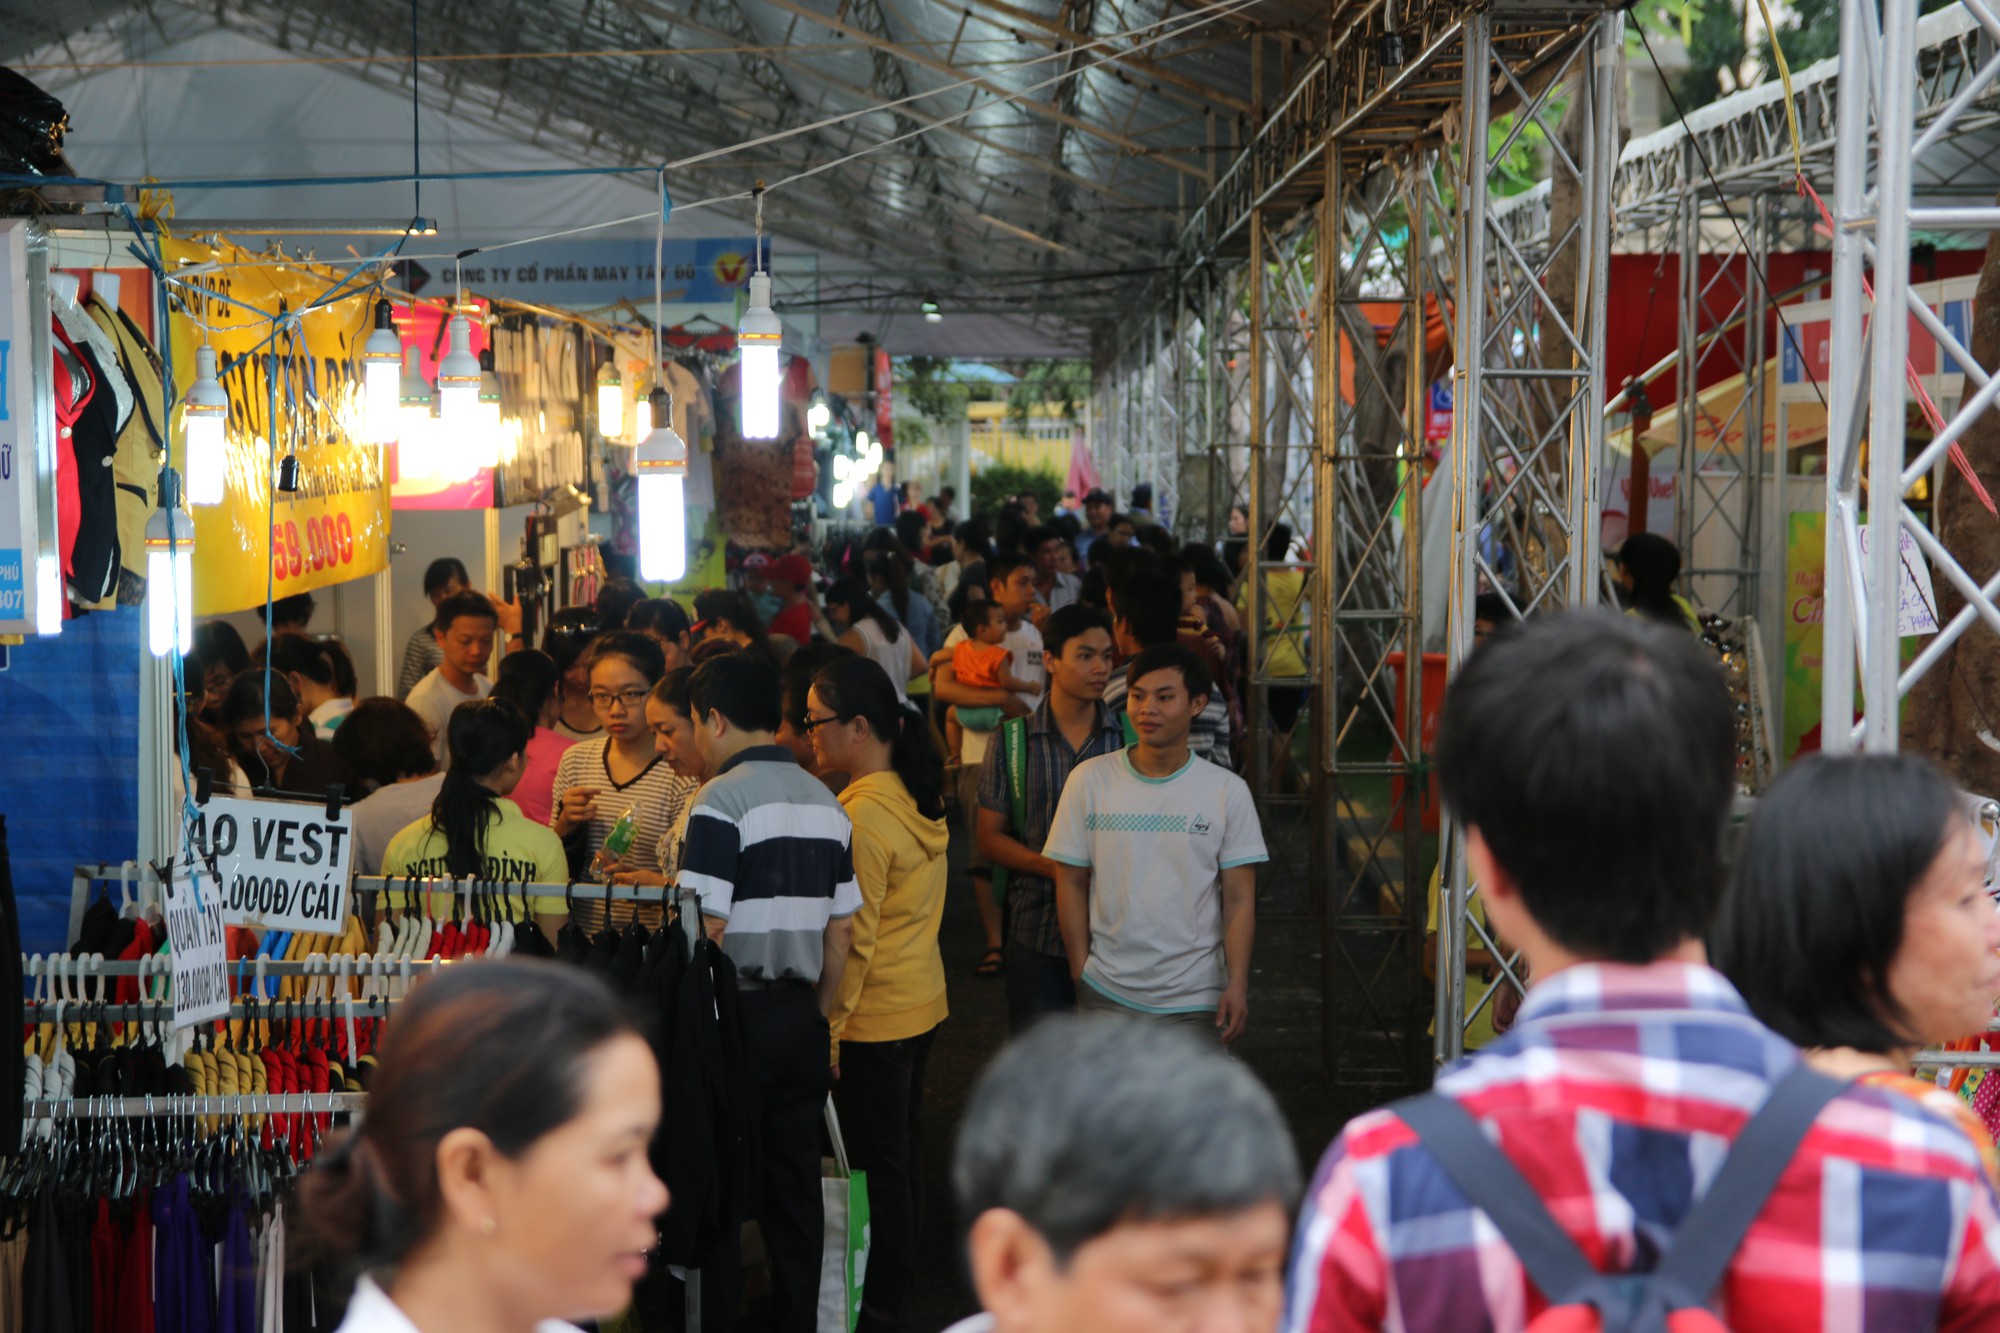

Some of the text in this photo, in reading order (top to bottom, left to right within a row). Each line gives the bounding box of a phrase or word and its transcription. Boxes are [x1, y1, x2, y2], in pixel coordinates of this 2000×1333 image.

[492, 267, 511, 282] TY
[593, 266, 630, 281] MAY
[252, 817, 348, 868] VEST
[487, 850, 537, 882] ĐÌNH
